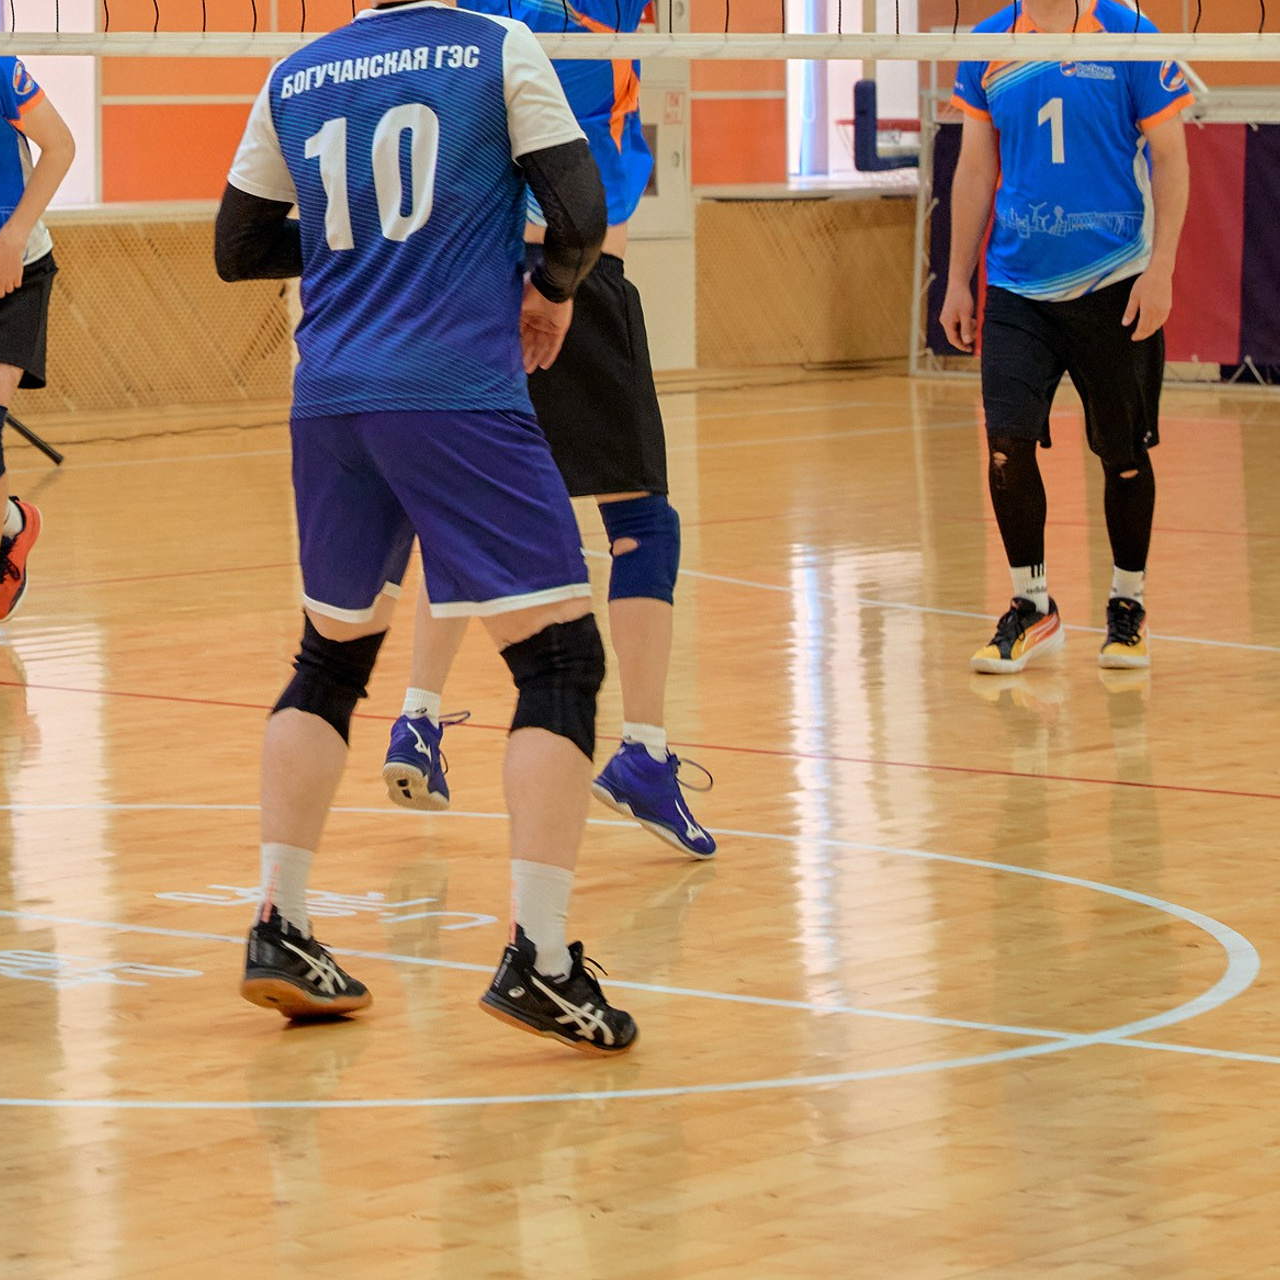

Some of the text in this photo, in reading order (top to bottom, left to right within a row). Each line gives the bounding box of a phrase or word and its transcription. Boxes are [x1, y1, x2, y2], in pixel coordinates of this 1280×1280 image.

[281, 44, 481, 100] БОГУЧАНСКАЯ ГЭС
[1037, 96, 1065, 164] 1
[304, 102, 440, 252] 10
